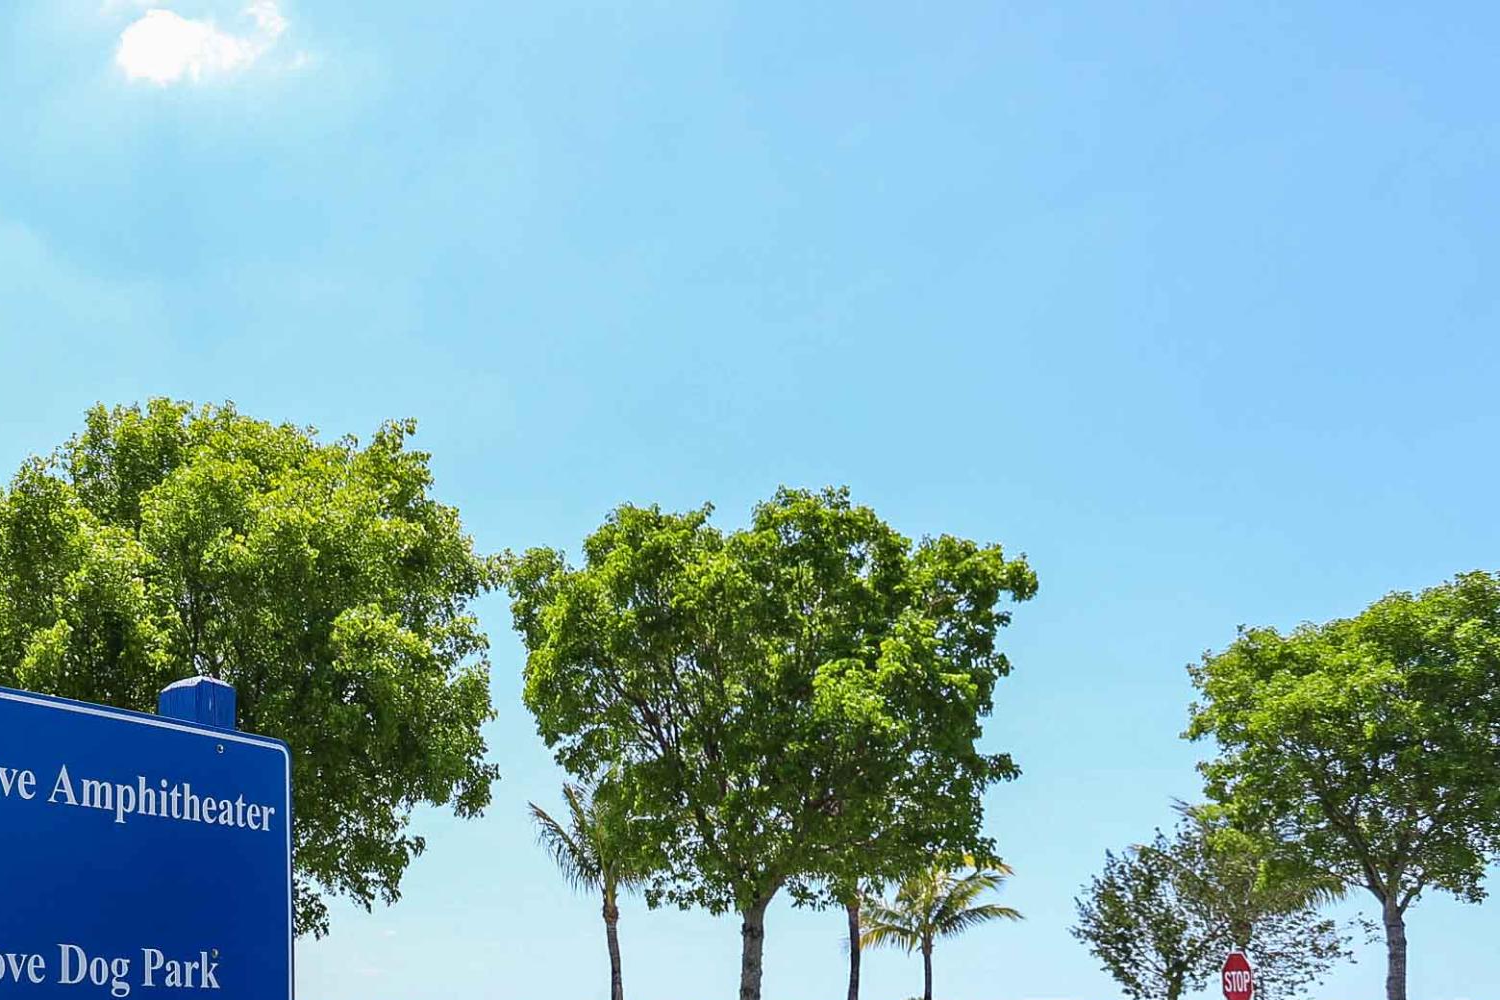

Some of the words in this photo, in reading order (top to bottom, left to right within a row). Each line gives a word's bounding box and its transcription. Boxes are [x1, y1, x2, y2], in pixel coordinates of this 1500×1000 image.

[47, 764, 276, 832] Amphitheater
[57, 943, 131, 998] Dog
[141, 948, 221, 989] Park
[1224, 970, 1250, 992] STOP
